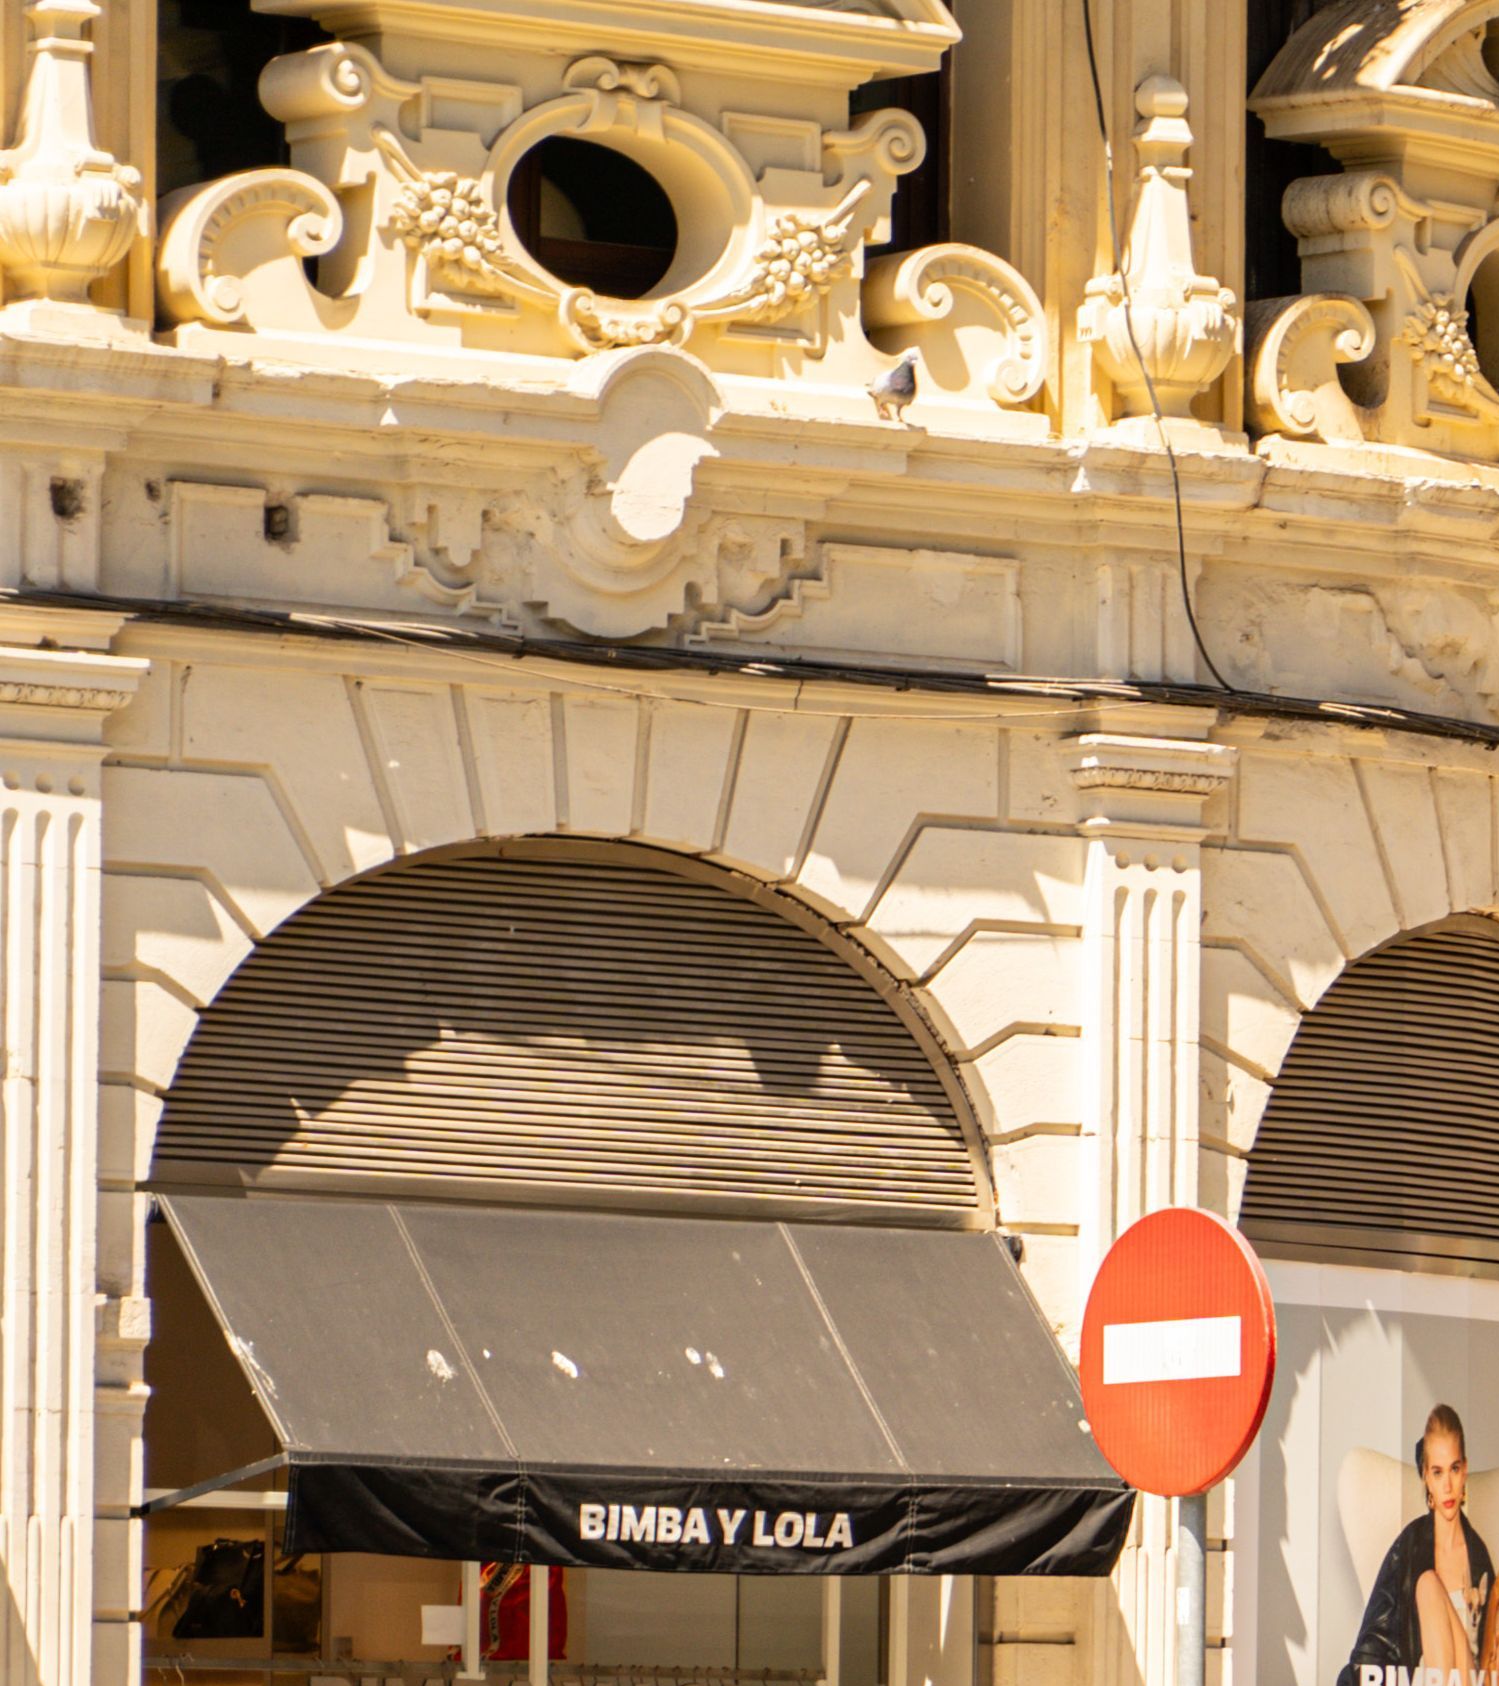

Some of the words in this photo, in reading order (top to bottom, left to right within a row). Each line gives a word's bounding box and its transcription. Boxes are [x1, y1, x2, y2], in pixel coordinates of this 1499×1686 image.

[579, 1503, 711, 1544] BIMBA
[717, 1508, 747, 1545] Y
[753, 1510, 853, 1548] LOLA
